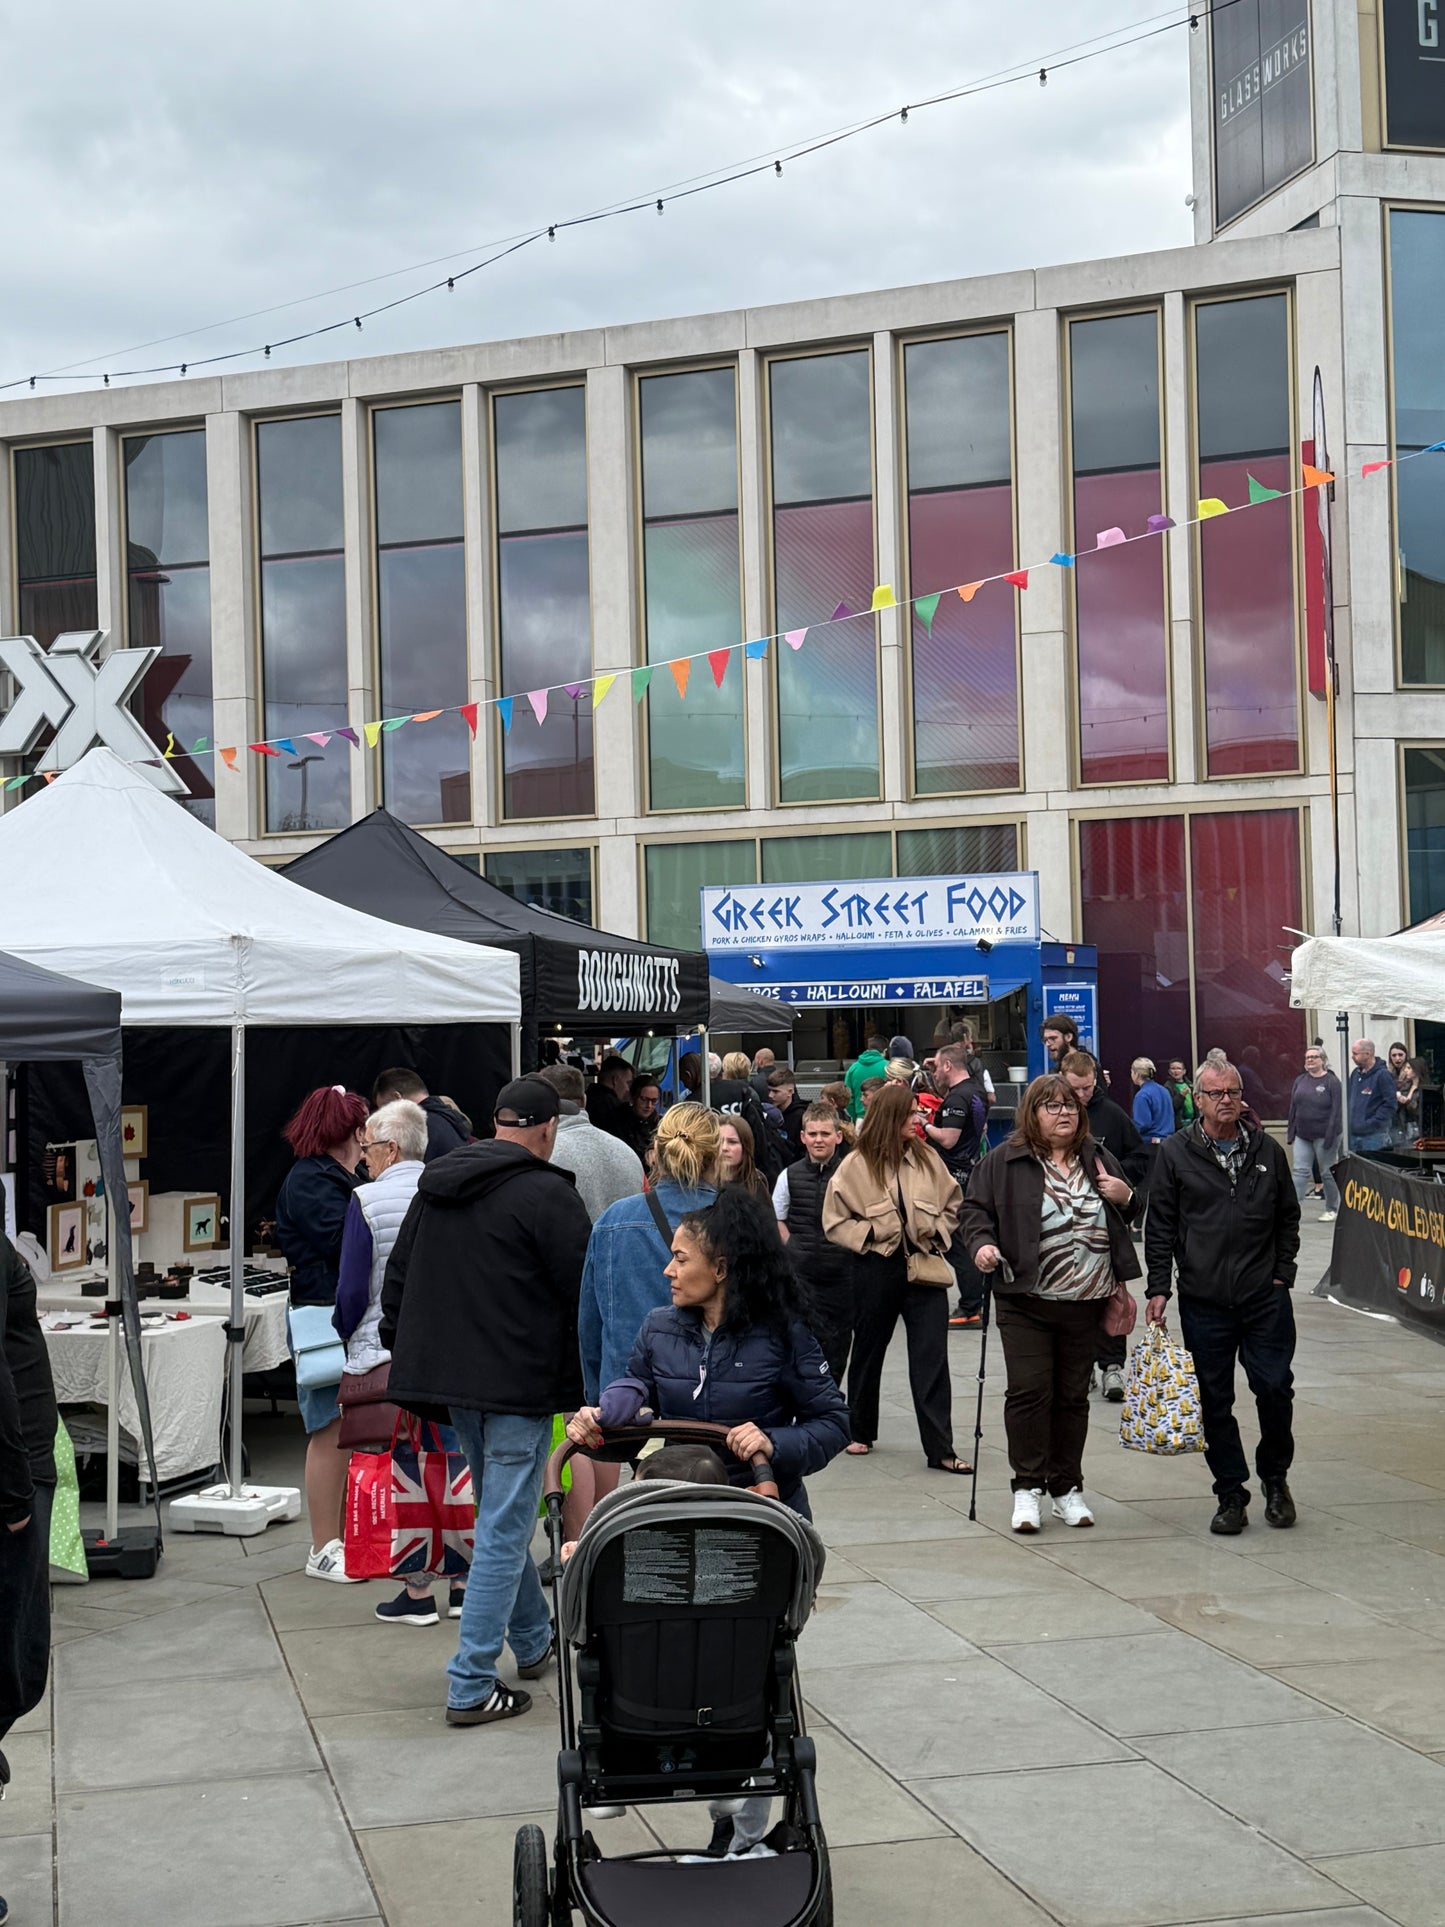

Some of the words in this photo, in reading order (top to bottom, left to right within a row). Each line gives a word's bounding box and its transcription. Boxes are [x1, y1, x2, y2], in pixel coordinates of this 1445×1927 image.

[712, 892, 803, 932] GREEK
[821, 887, 929, 928] STREET
[946, 882, 1027, 924] FOOD
[712, 936, 731, 945] PORK
[741, 935, 772, 943] CHICKEN
[774, 934, 799, 943] GYROS
[800, 933, 826, 941] WRAPS
[836, 931, 875, 940] HALLOUMI
[884, 930, 904, 939] FETA
[915, 928, 943, 937] OLIVES
[1004, 926, 1028, 935] FRIES
[577, 949, 681, 1013] DOUGHNOTTS
[806, 983, 886, 1002] HALLOUMI
[913, 980, 984, 998] FALAFEL
